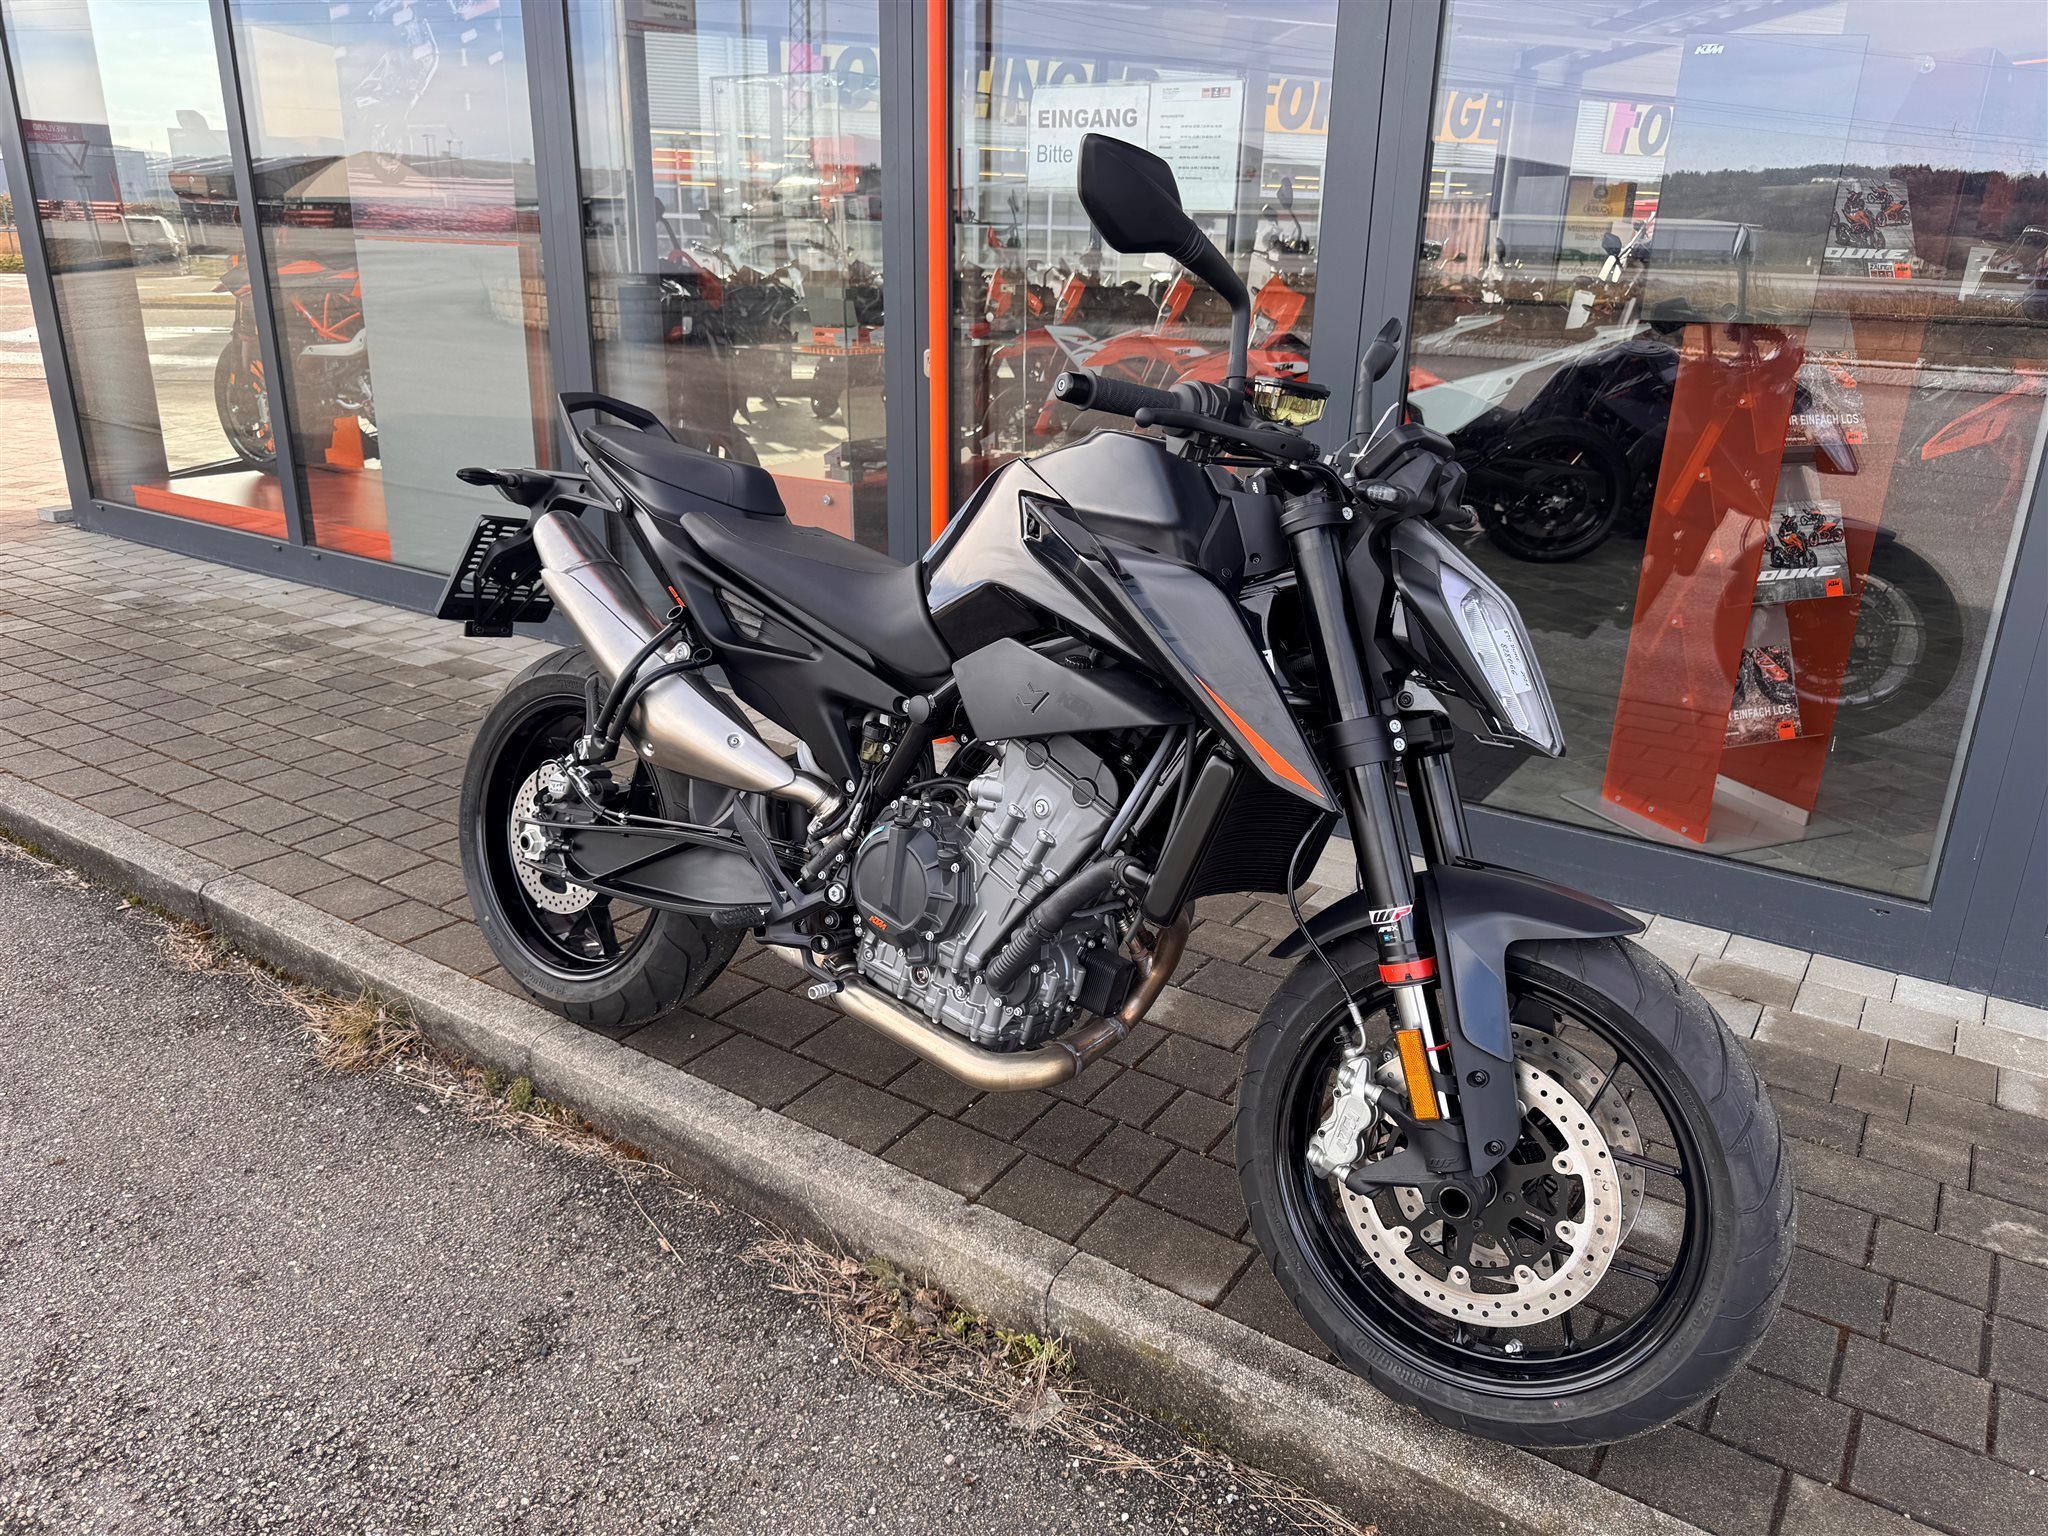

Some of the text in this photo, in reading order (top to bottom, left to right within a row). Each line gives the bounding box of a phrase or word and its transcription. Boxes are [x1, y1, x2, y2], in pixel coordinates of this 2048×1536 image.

[1695, 44, 1724, 54] KTM
[1038, 108, 1138, 128] EINGANG
[1037, 144, 1073, 163] Bitte
[1824, 247, 1909, 259] DUKE
[1274, 363, 1294, 372] KTM
[1800, 414, 1839, 425] EINFACH
[1841, 413, 1860, 424] LOS
[1757, 564, 1841, 582] DUKE
[1733, 703, 1792, 720] EINFACH LOS
[868, 915, 888, 930] KTM
